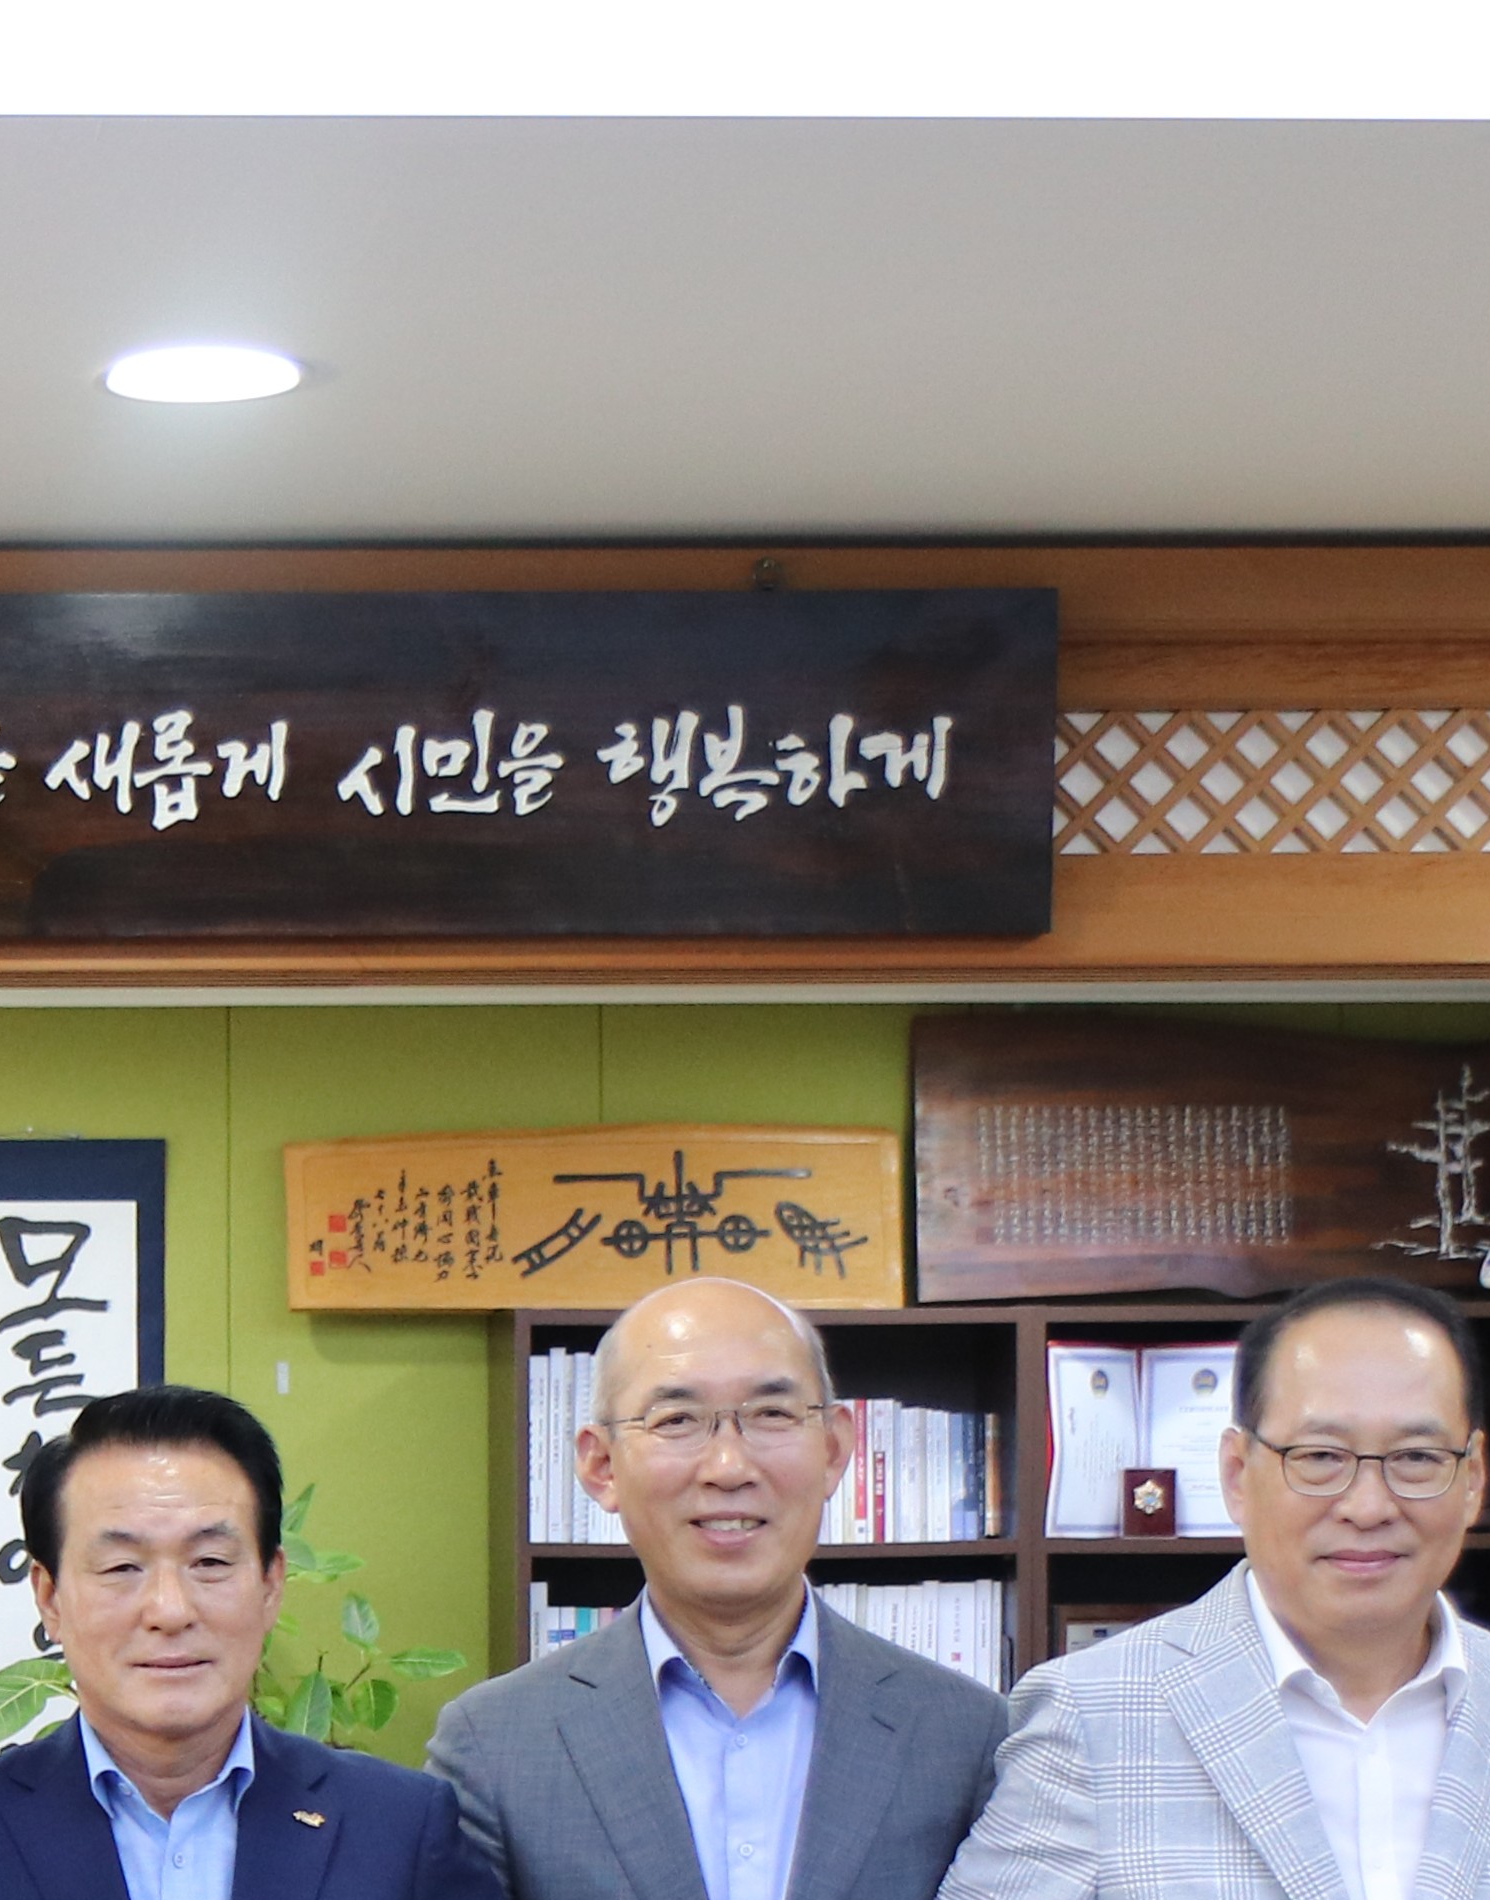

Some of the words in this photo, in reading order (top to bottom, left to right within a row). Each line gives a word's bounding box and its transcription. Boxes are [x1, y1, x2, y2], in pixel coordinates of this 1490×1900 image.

[43, 708, 288, 831] 새롭게
[336, 708, 564, 815] 시민을
[596, 704, 953, 826] 행복하게
